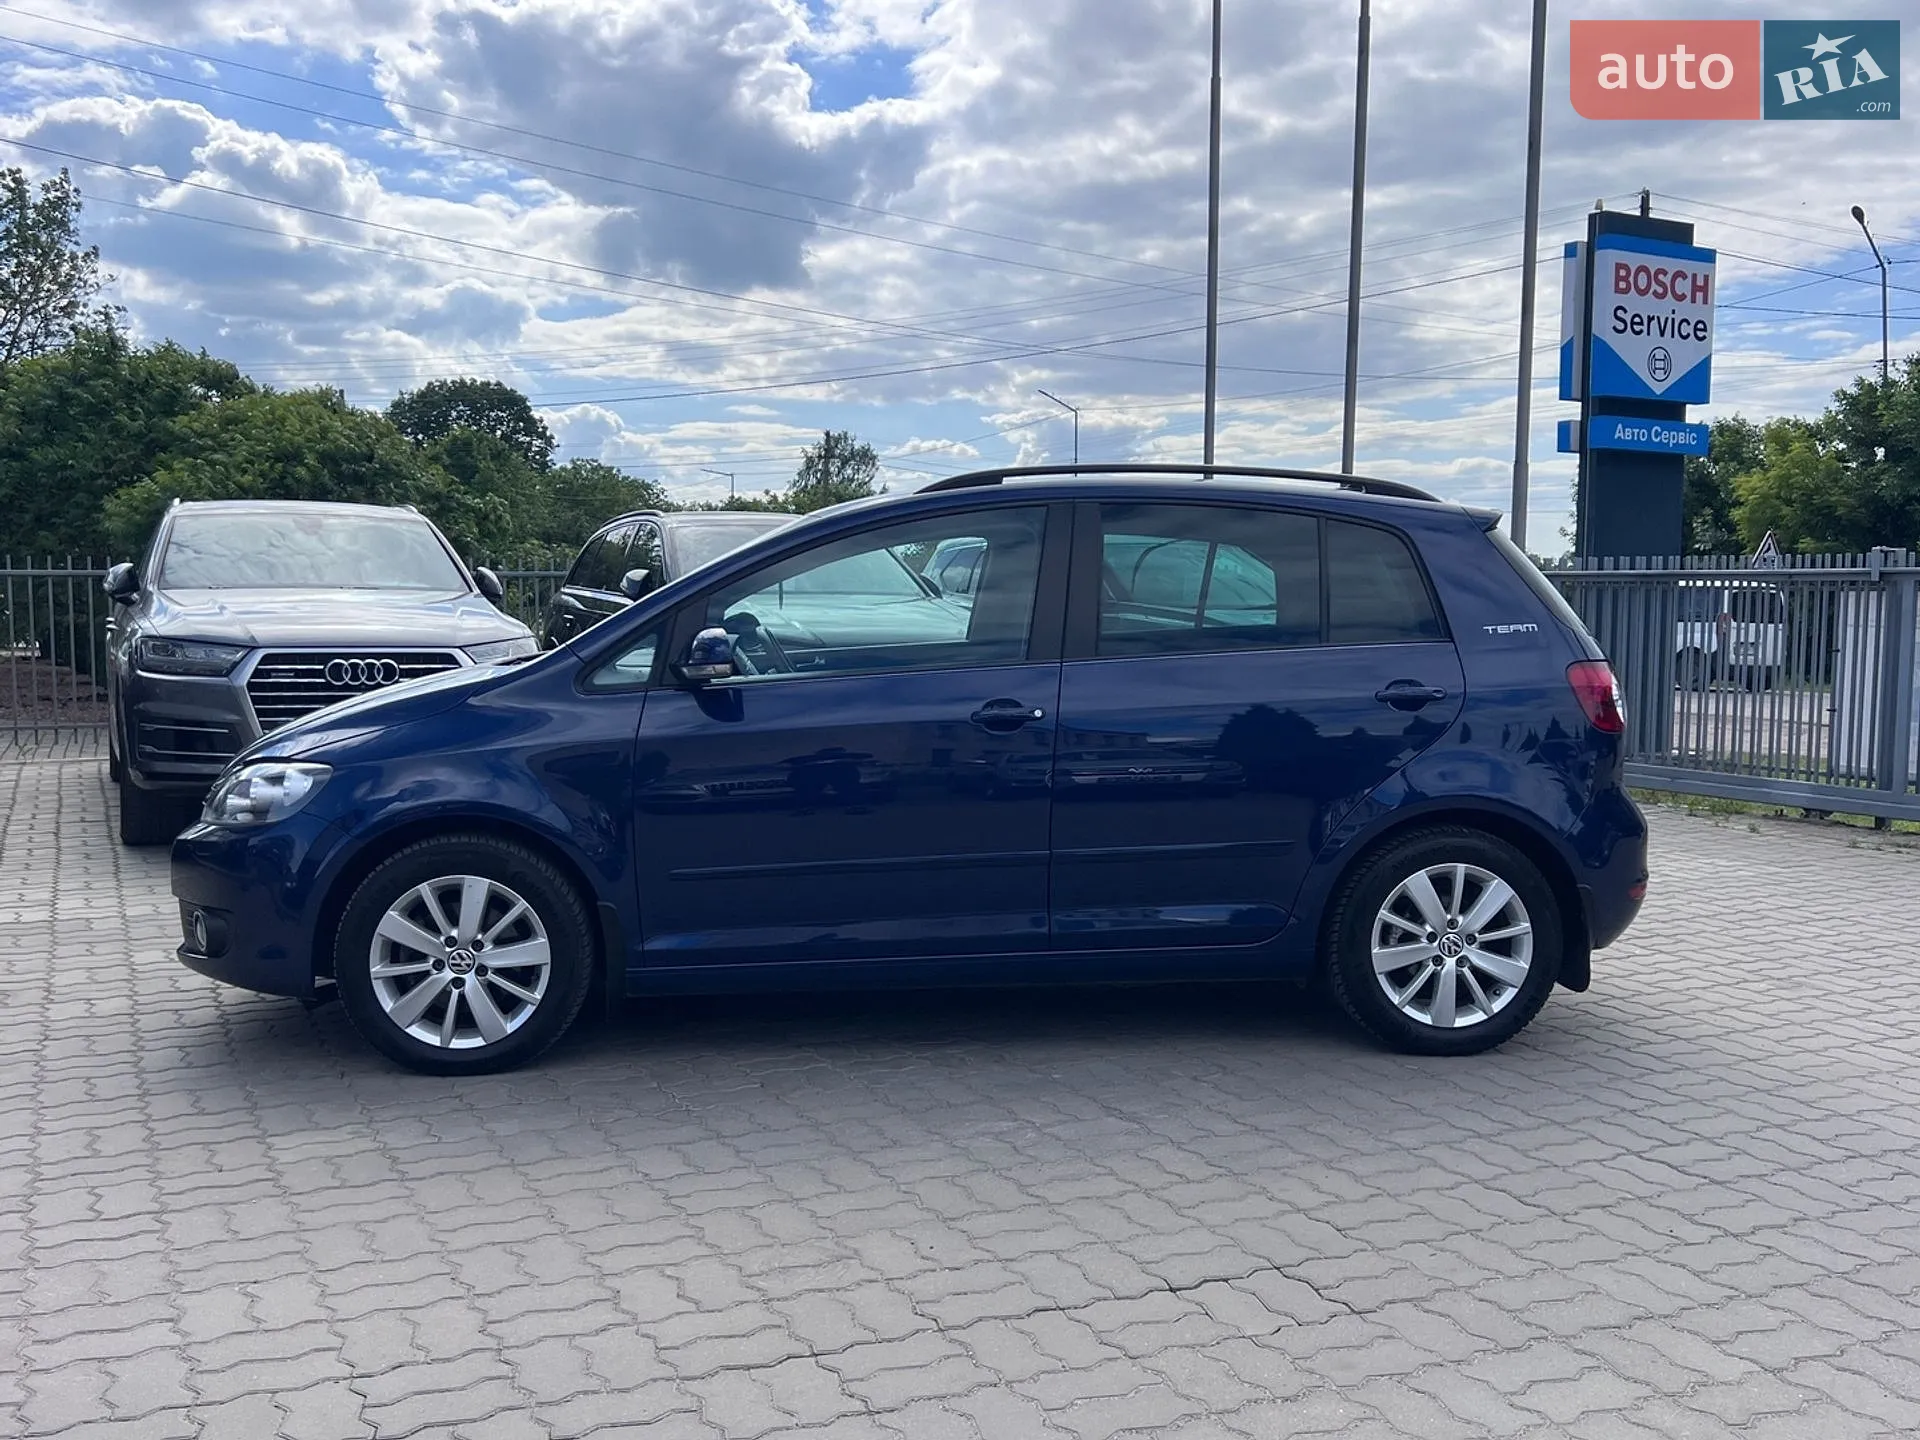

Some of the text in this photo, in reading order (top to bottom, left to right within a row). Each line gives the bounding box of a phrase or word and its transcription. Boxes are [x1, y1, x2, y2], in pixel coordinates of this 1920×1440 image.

[1614, 262, 1710, 305] BOSCH
[1612, 305, 1708, 342] Service
[1614, 423, 1697, 448] Авто Сервіс
[1483, 623, 1538, 634] TEAM
